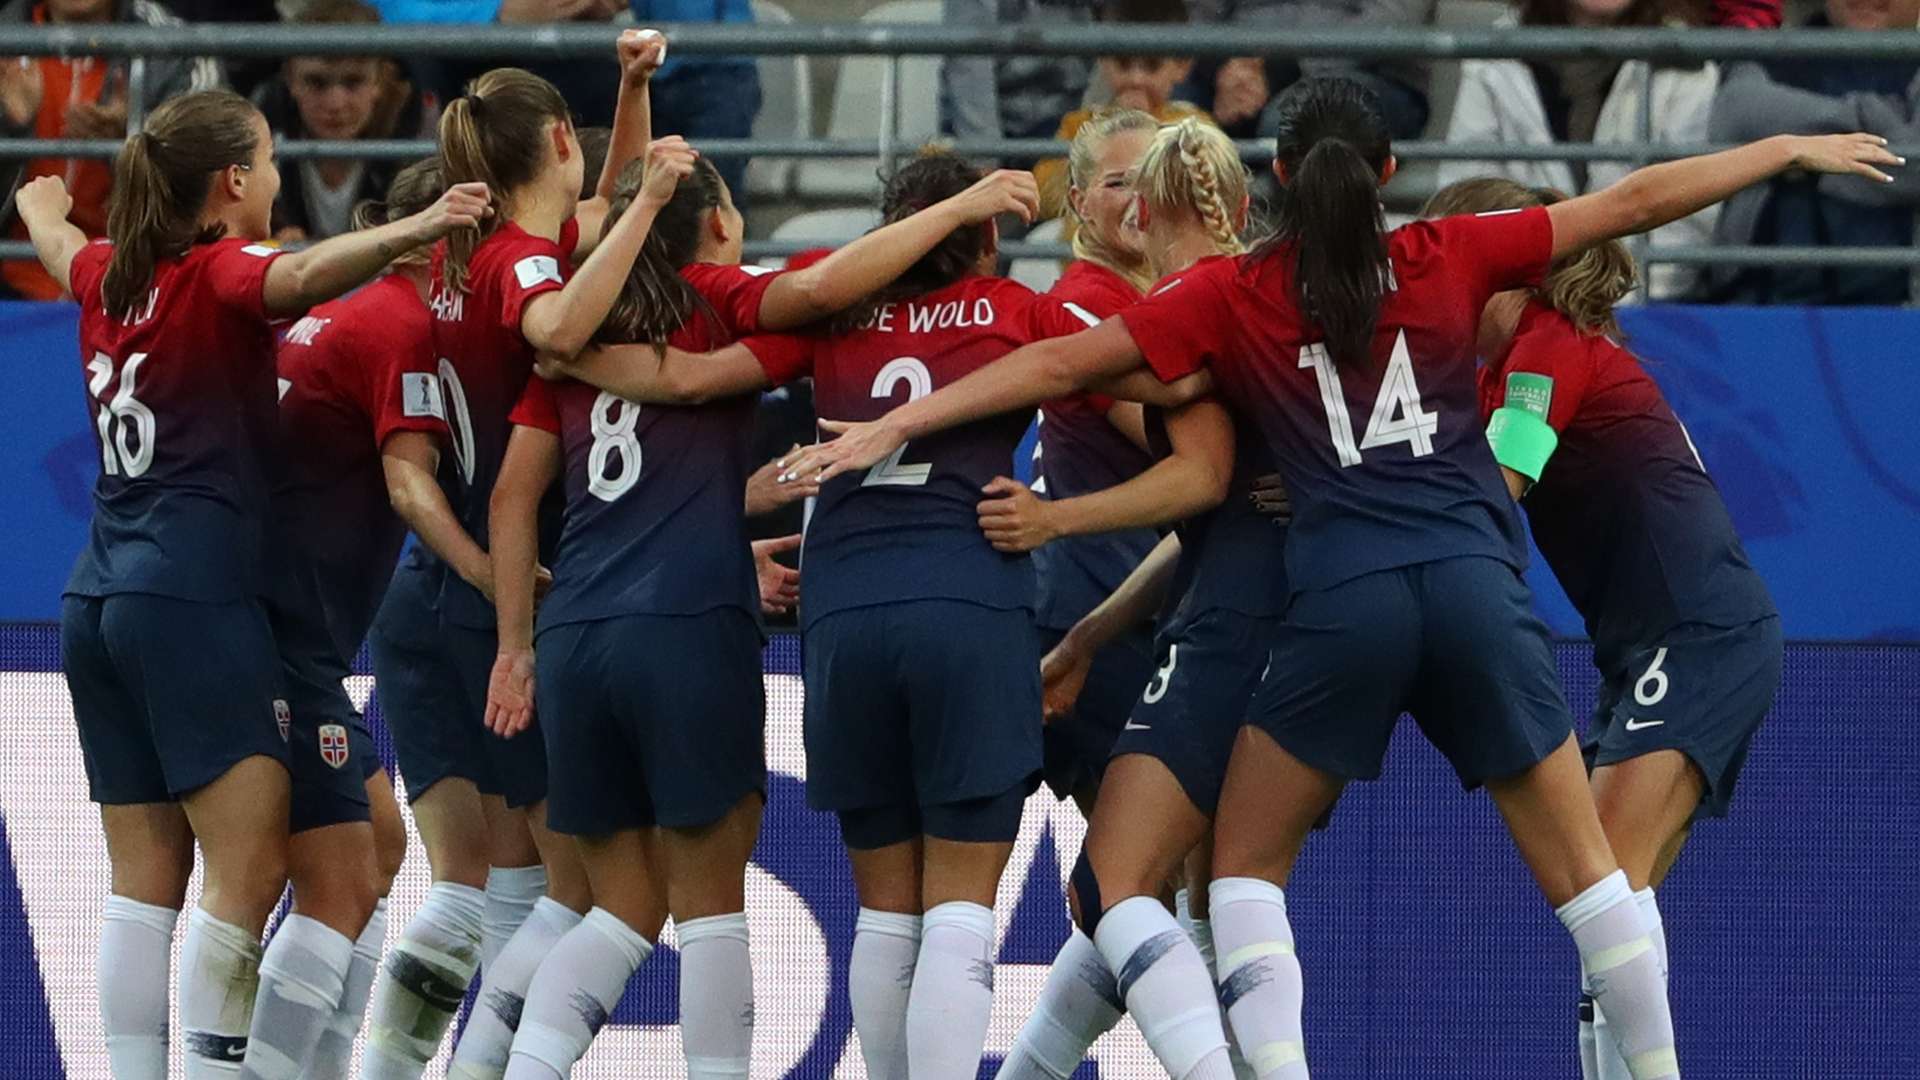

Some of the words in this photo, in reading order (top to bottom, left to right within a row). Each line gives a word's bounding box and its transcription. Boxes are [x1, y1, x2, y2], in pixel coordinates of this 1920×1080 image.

[908, 298, 994, 333] WOLD
[87, 351, 156, 478] 16
[588, 391, 642, 502] 8
[861, 356, 933, 487] 2
[1298, 327, 1438, 468] 14
[1634, 648, 1668, 706] 6
